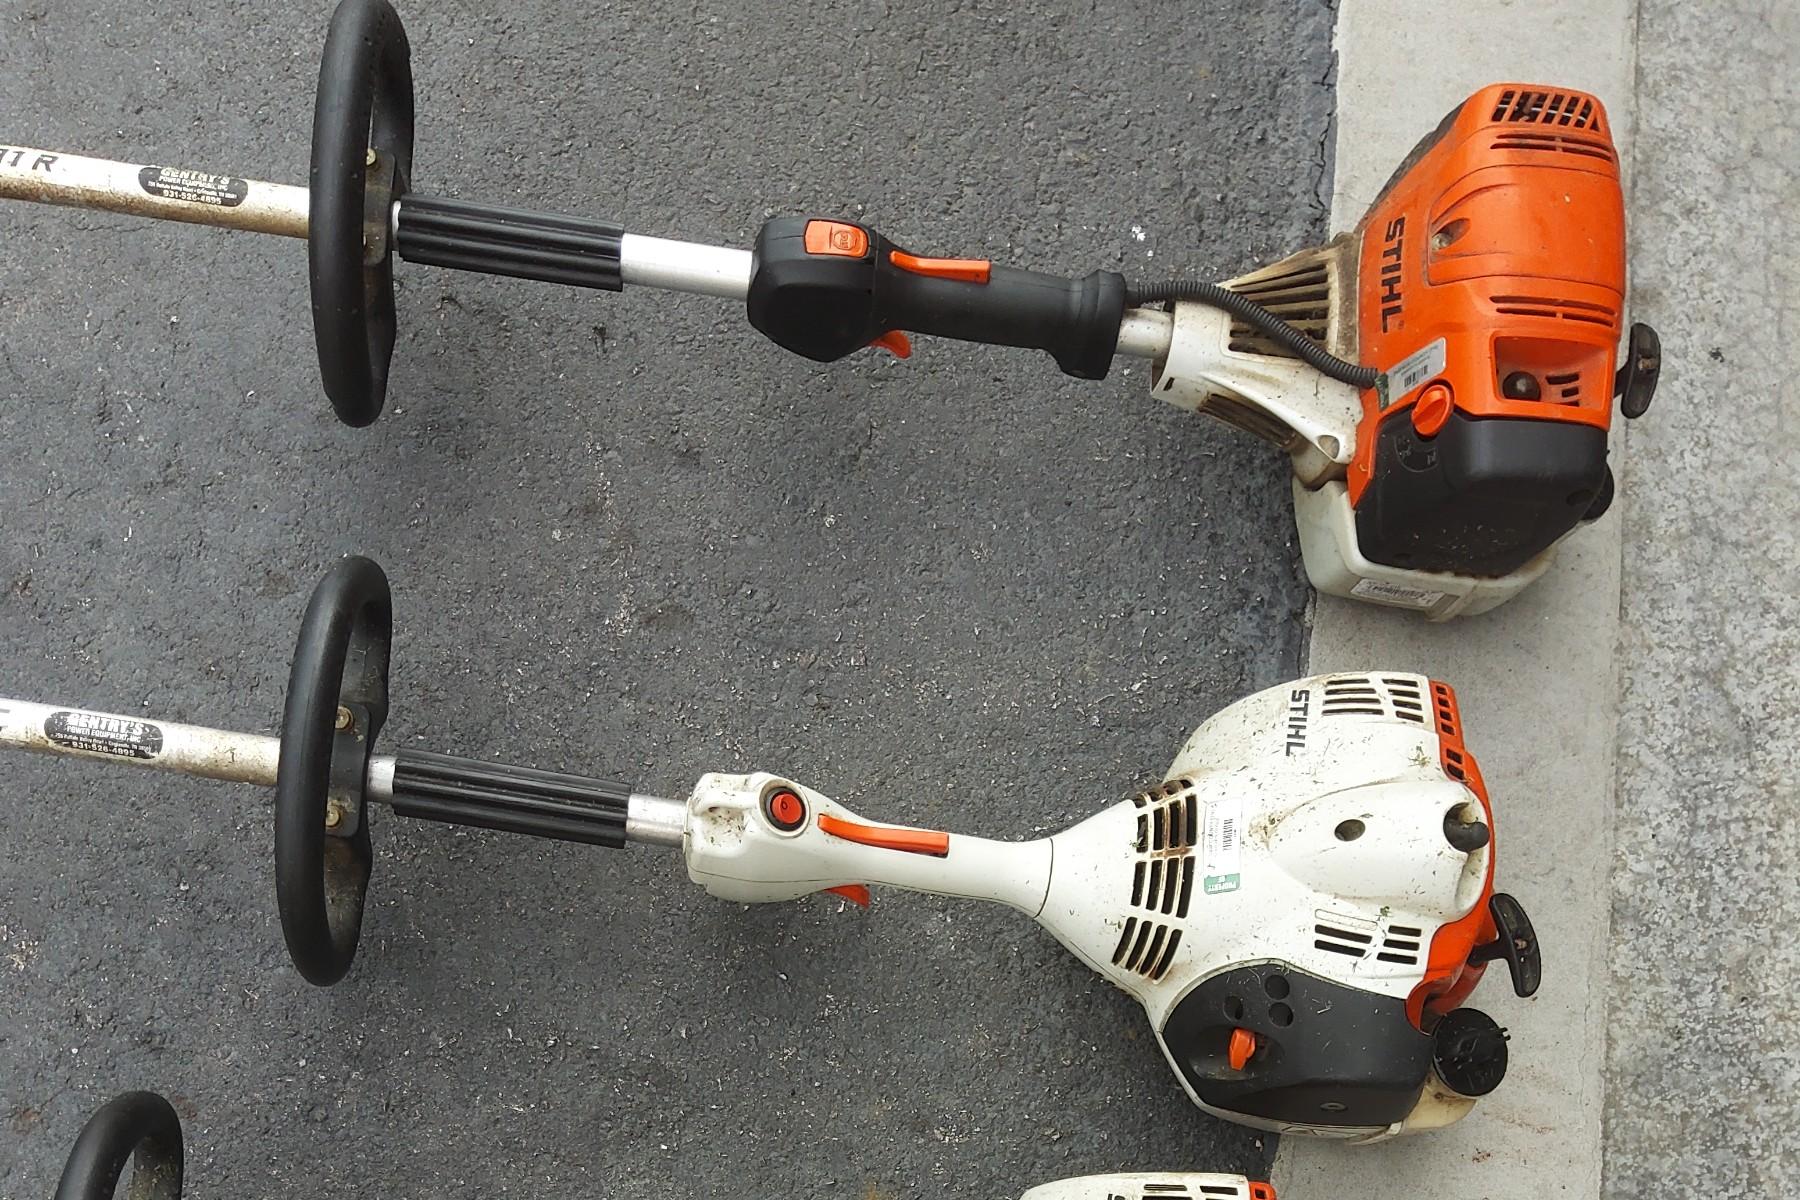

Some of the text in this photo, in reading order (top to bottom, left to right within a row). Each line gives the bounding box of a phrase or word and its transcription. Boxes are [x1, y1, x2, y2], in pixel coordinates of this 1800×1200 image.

[32, 154, 59, 172] R
[1382, 216, 1405, 333] STIHL
[1286, 690, 1310, 757] STIHL
[71, 741, 135, 756] 931-526-4895
